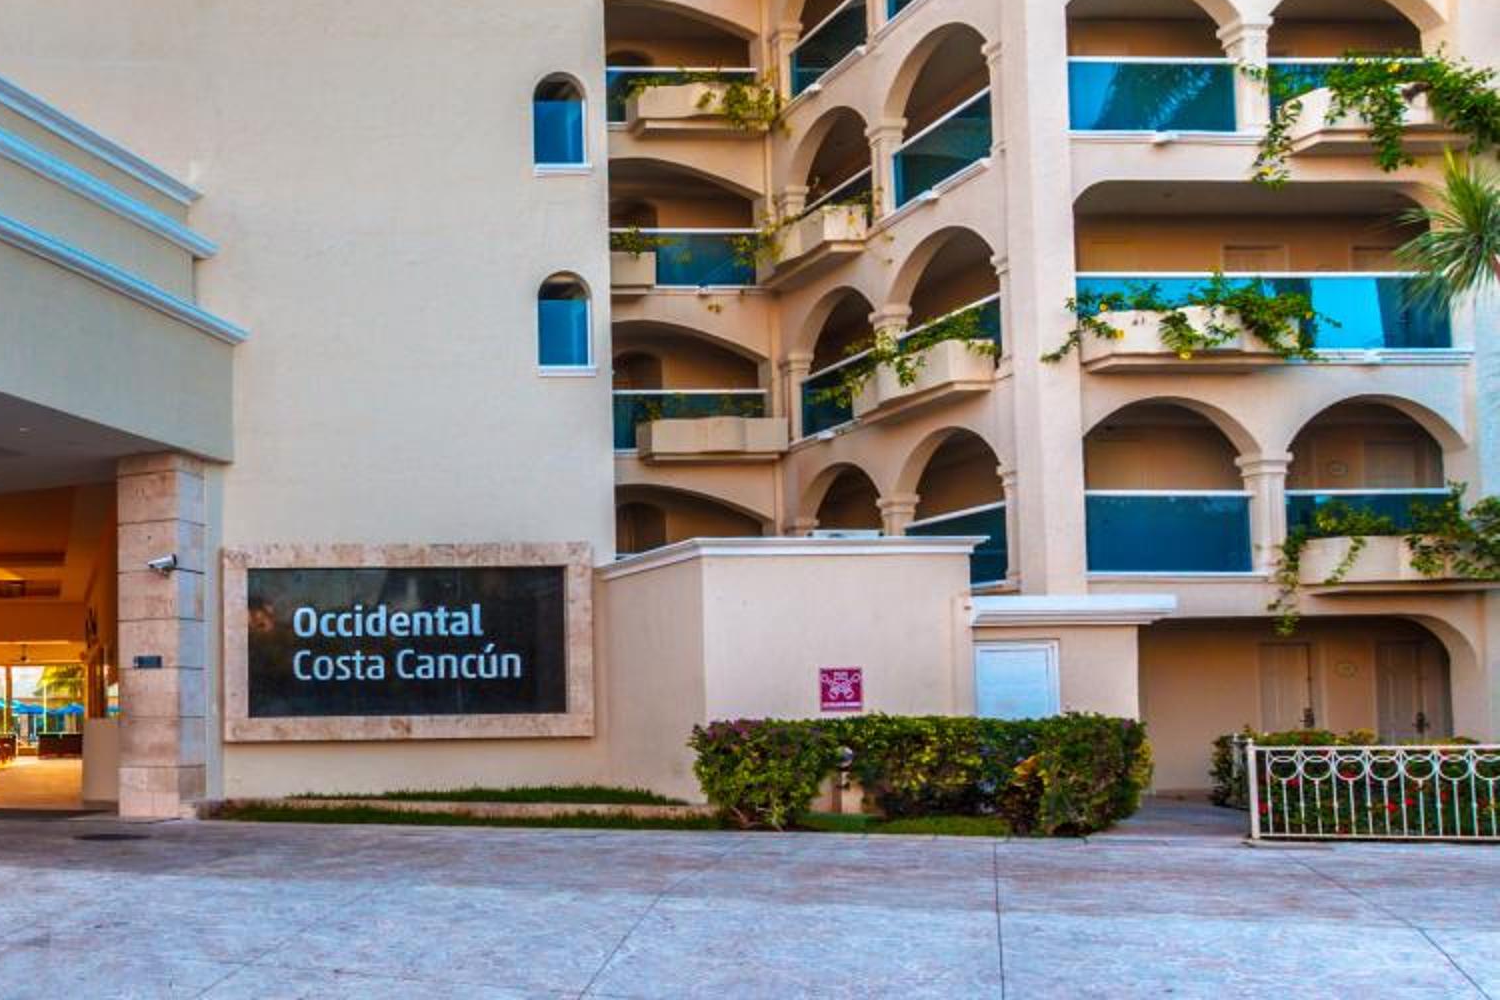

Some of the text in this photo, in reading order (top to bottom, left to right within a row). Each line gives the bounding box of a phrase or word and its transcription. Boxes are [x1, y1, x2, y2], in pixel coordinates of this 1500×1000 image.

[293, 603, 484, 637] Occidental
[292, 643, 522, 680] Costa Cancún
